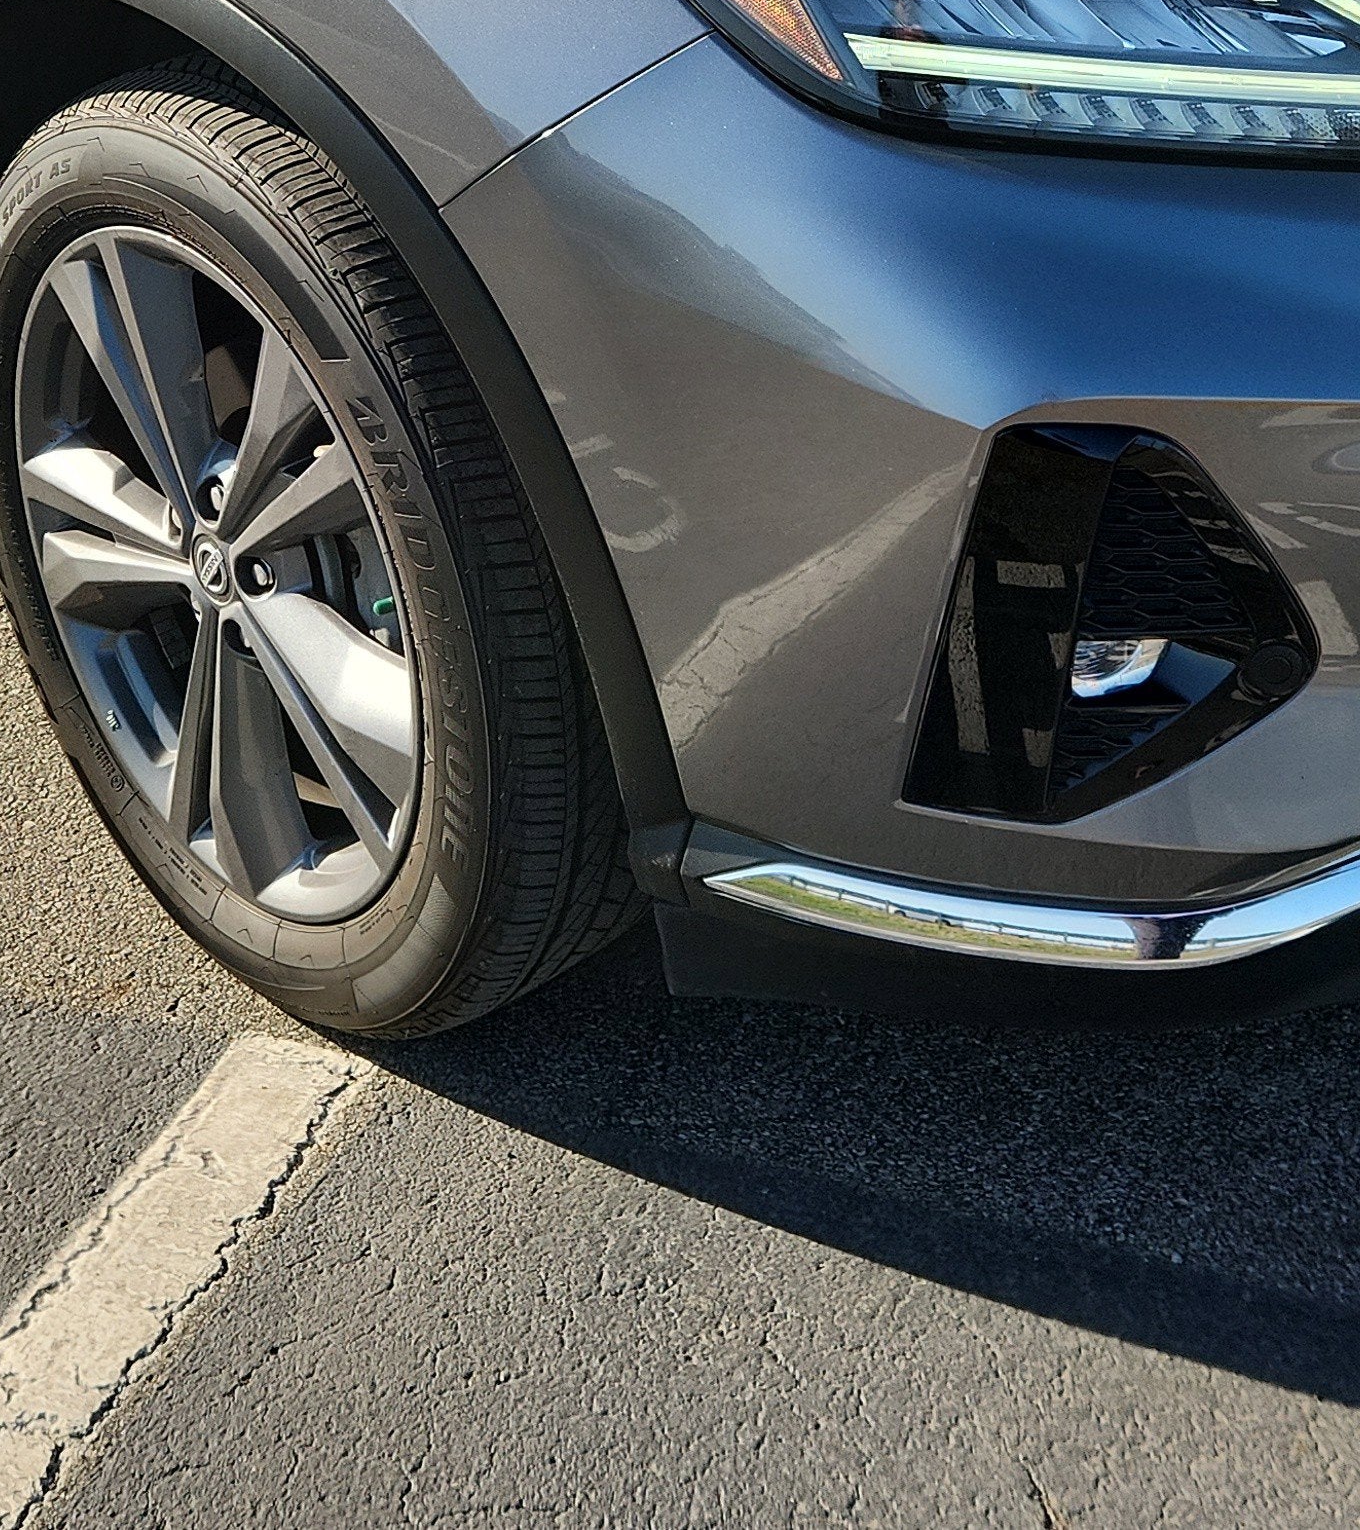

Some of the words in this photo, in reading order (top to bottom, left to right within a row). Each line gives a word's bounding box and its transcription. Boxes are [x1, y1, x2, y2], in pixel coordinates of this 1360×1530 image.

[1, 171, 43, 228] SPORT
[49, 157, 72, 180] AS
[346, 395, 478, 867] BRIDGESTONE
